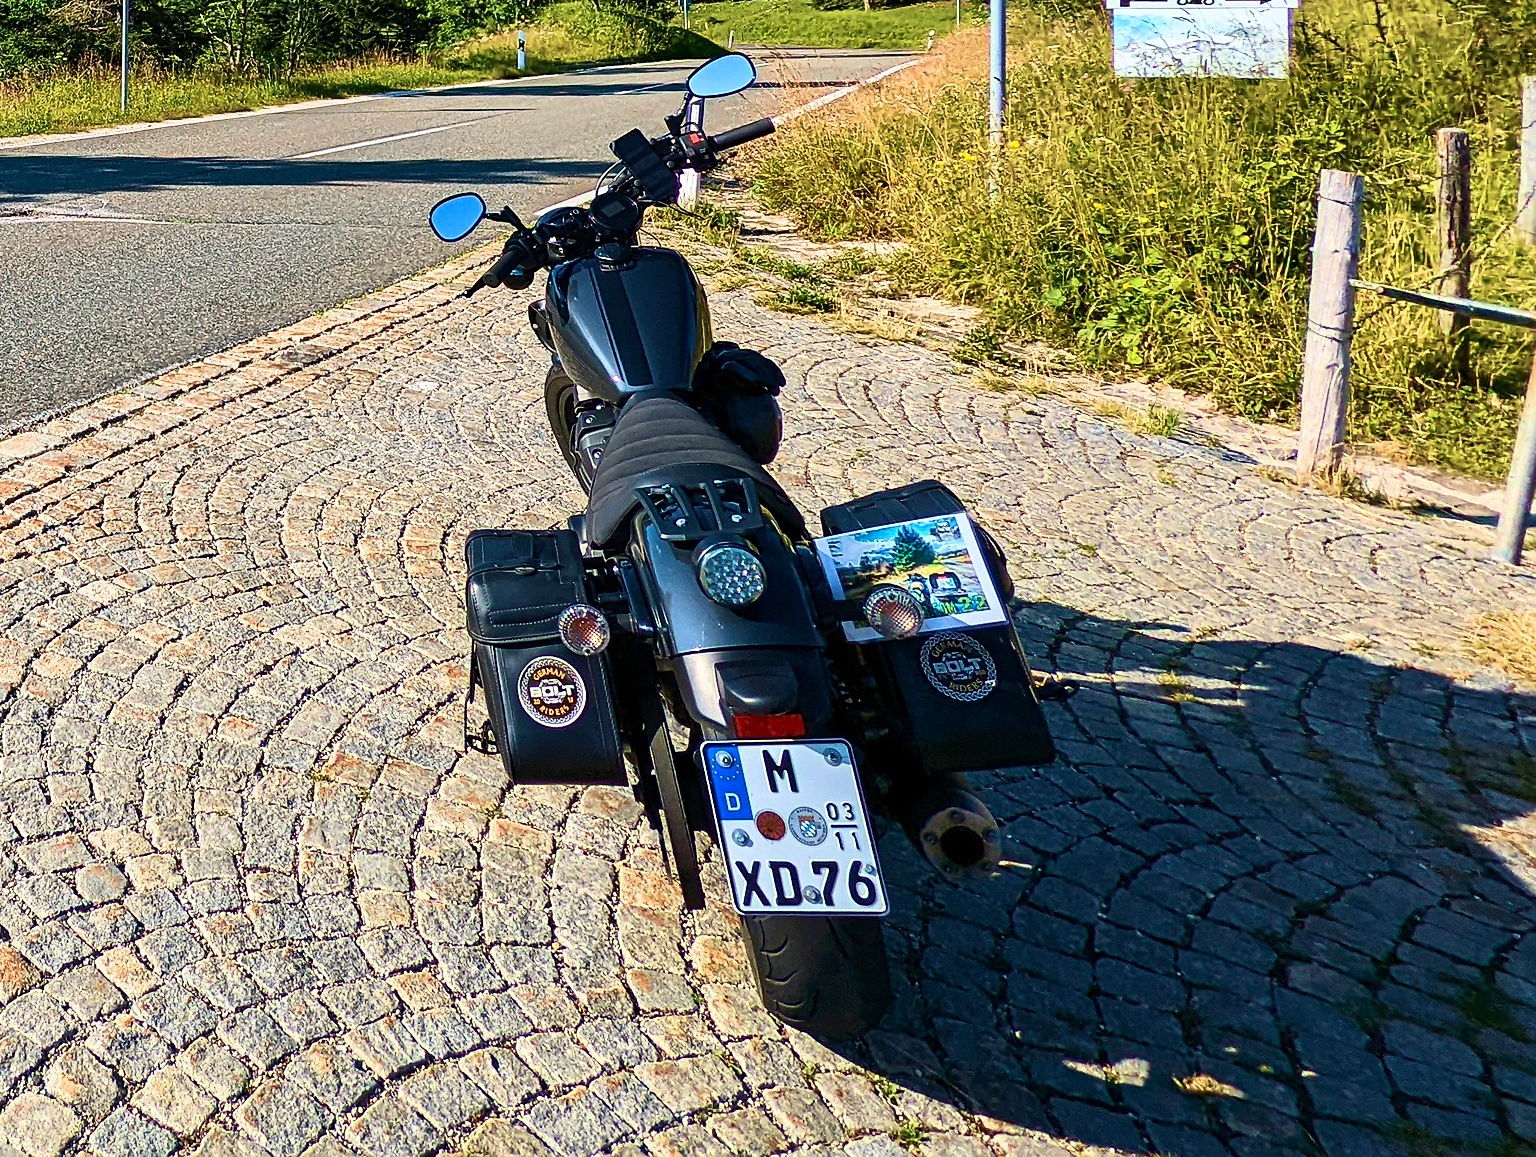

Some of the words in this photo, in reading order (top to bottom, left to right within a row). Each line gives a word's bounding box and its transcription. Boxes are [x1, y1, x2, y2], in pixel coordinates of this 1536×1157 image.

[533, 667, 565, 681] GERMAN
[933, 658, 981, 674] BOLT
[529, 685, 575, 698] BOLT
[949, 678, 983, 692] RIDERS
[539, 705, 569, 716] RIDERS
[762, 749, 799, 793] M
[725, 793, 741, 811] D
[826, 802, 854, 821] 03
[835, 832, 860, 851] 11
[735, 861, 803, 907] XD
[811, 860, 877, 907] 76
